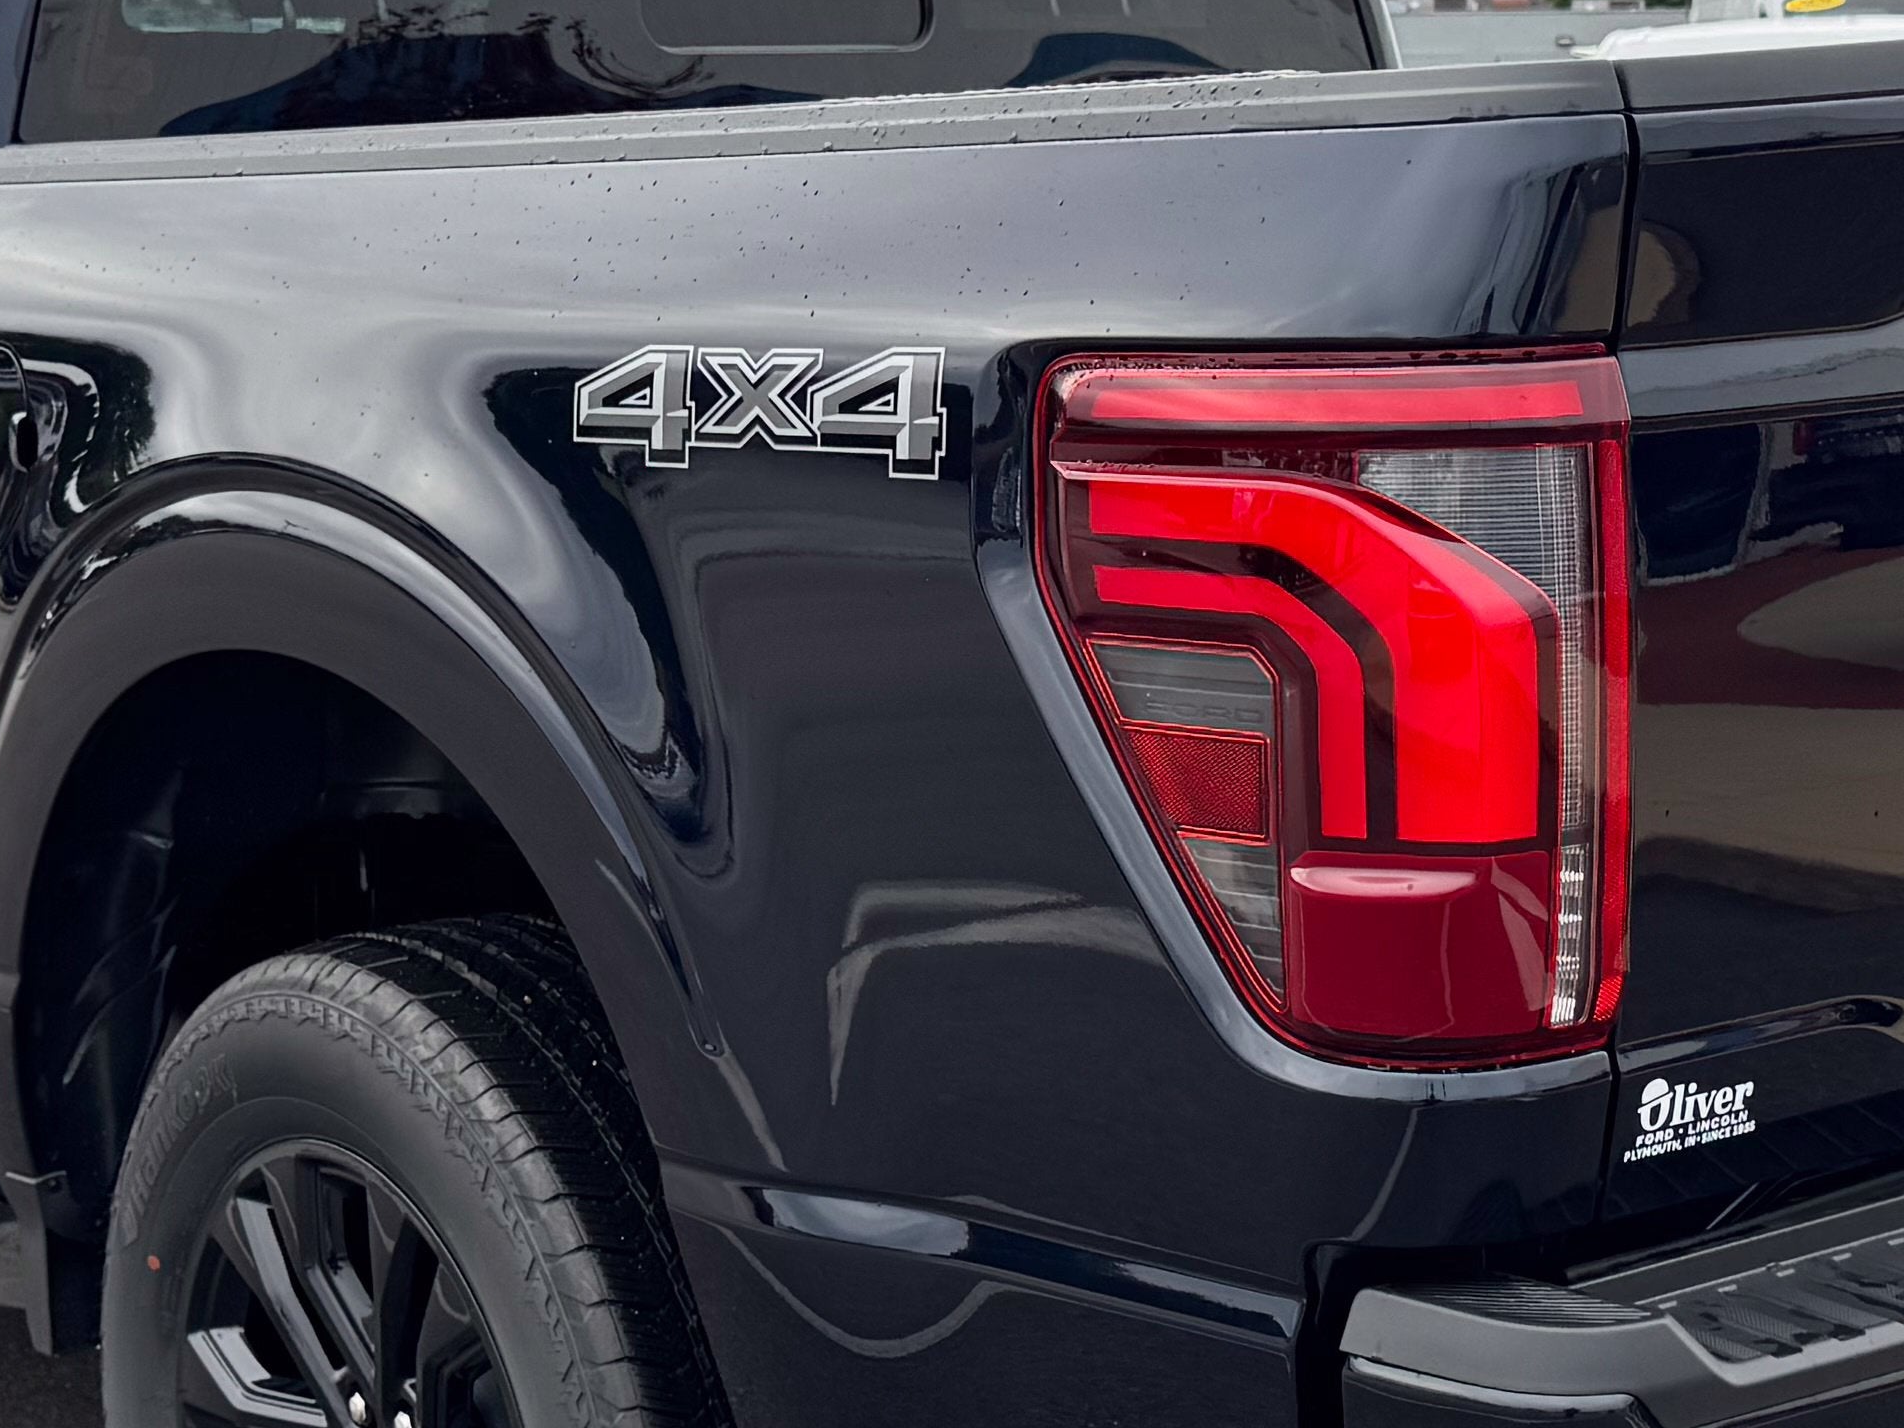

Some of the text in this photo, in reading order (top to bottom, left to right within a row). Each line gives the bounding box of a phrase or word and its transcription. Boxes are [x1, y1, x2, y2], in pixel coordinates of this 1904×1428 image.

[1637, 1077, 1755, 1132] Oliver
[1635, 1109, 1748, 1147] FORD LINCOLN
[1684, 1134, 1696, 1148] IN
[1701, 1125, 1732, 1144] SINCE
